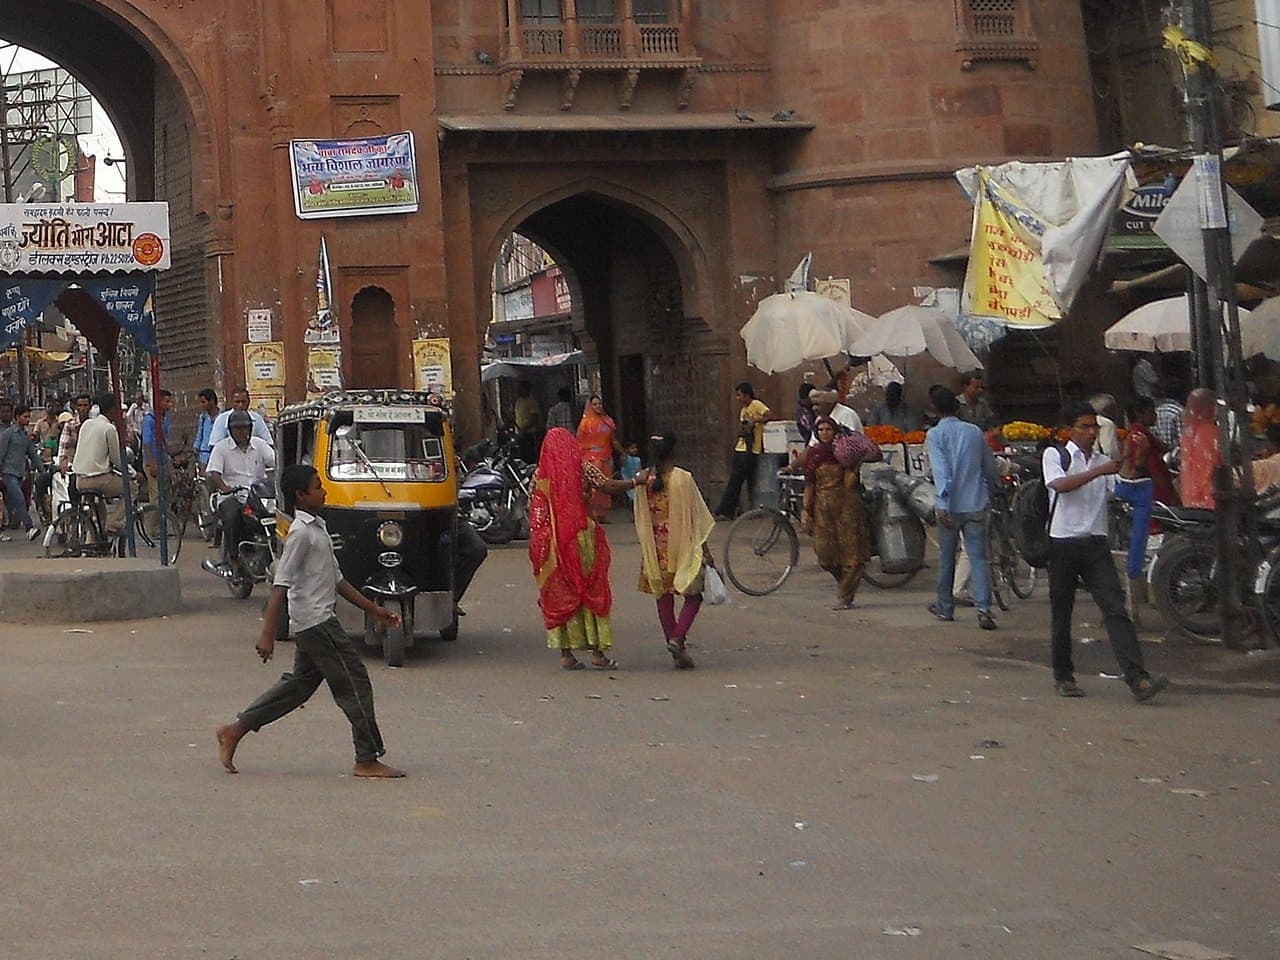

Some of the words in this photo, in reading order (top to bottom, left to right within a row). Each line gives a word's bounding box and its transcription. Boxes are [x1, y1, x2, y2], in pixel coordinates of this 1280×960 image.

[326, 158, 362, 172] विशाल
[18, 218, 71, 248] ज्योति
[71, 224, 95, 247] भोग
[96, 222, 134, 247] आटा
